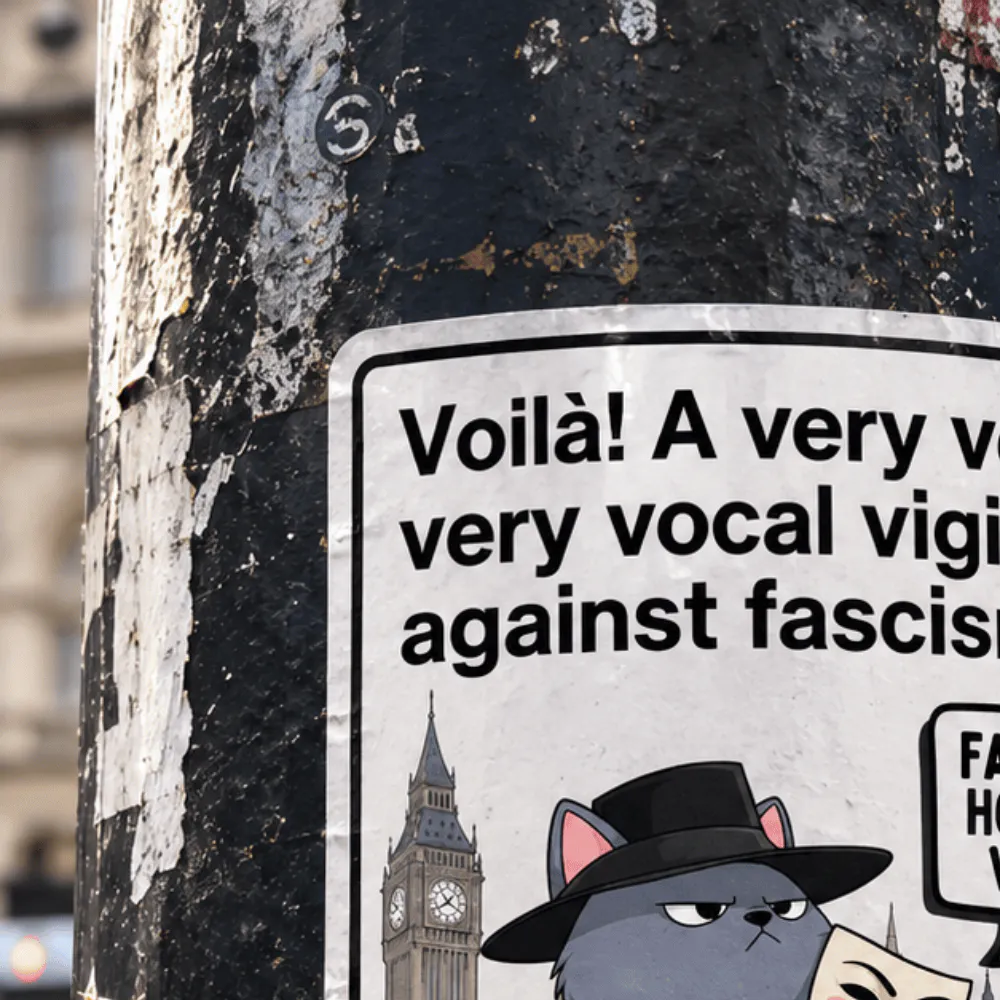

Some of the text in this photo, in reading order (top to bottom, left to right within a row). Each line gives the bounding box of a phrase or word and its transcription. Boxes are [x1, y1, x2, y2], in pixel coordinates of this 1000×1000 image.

[398, 390, 625, 476] Voilà!
[651, 389, 717, 460] A
[741, 407, 928, 481] very
[399, 506, 581, 578] very
[606, 484, 833, 557] vocal
[400, 581, 719, 679] against
